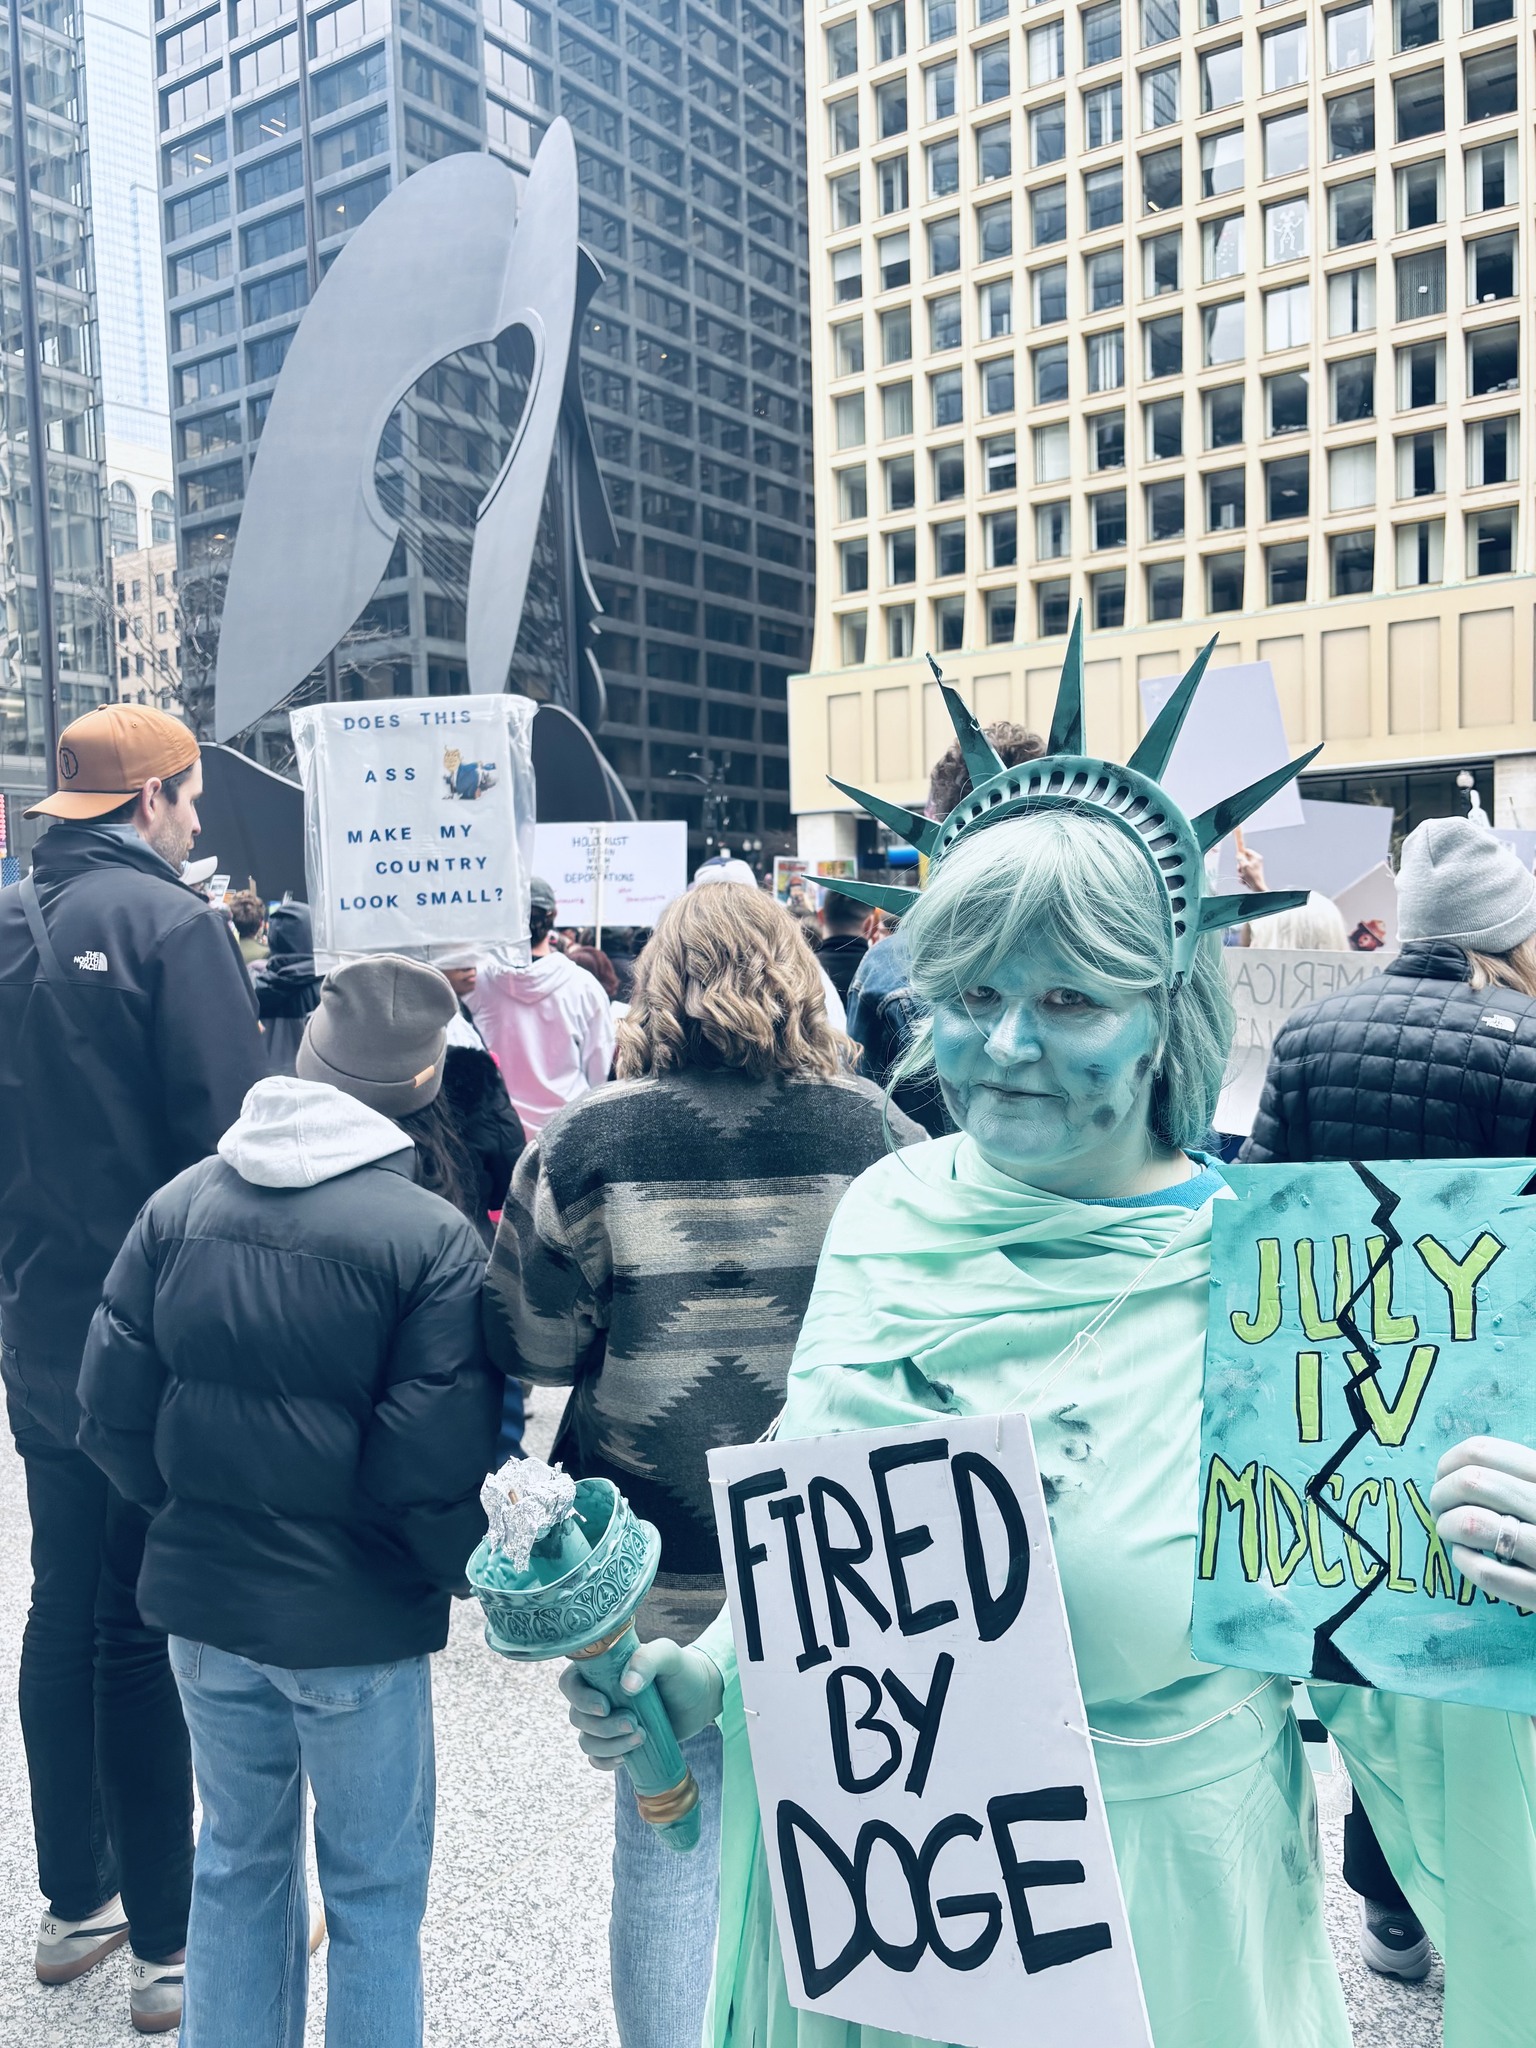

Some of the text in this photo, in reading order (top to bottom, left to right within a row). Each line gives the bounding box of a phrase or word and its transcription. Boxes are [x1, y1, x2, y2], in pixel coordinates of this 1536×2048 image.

[343, 710, 471, 730] DOES THIS
[365, 768, 416, 783] ASS
[348, 824, 472, 844] MAKE MY
[376, 856, 487, 874] COUNTRY
[340, 888, 503, 910] LOOK SMALL?
[1230, 1231, 1507, 1344] JULY
[1296, 1344, 1440, 1447] IV
[729, 1438, 1030, 1672] FIRED
[827, 1652, 955, 1798] BY
[777, 1786, 1112, 2000] DOGE
